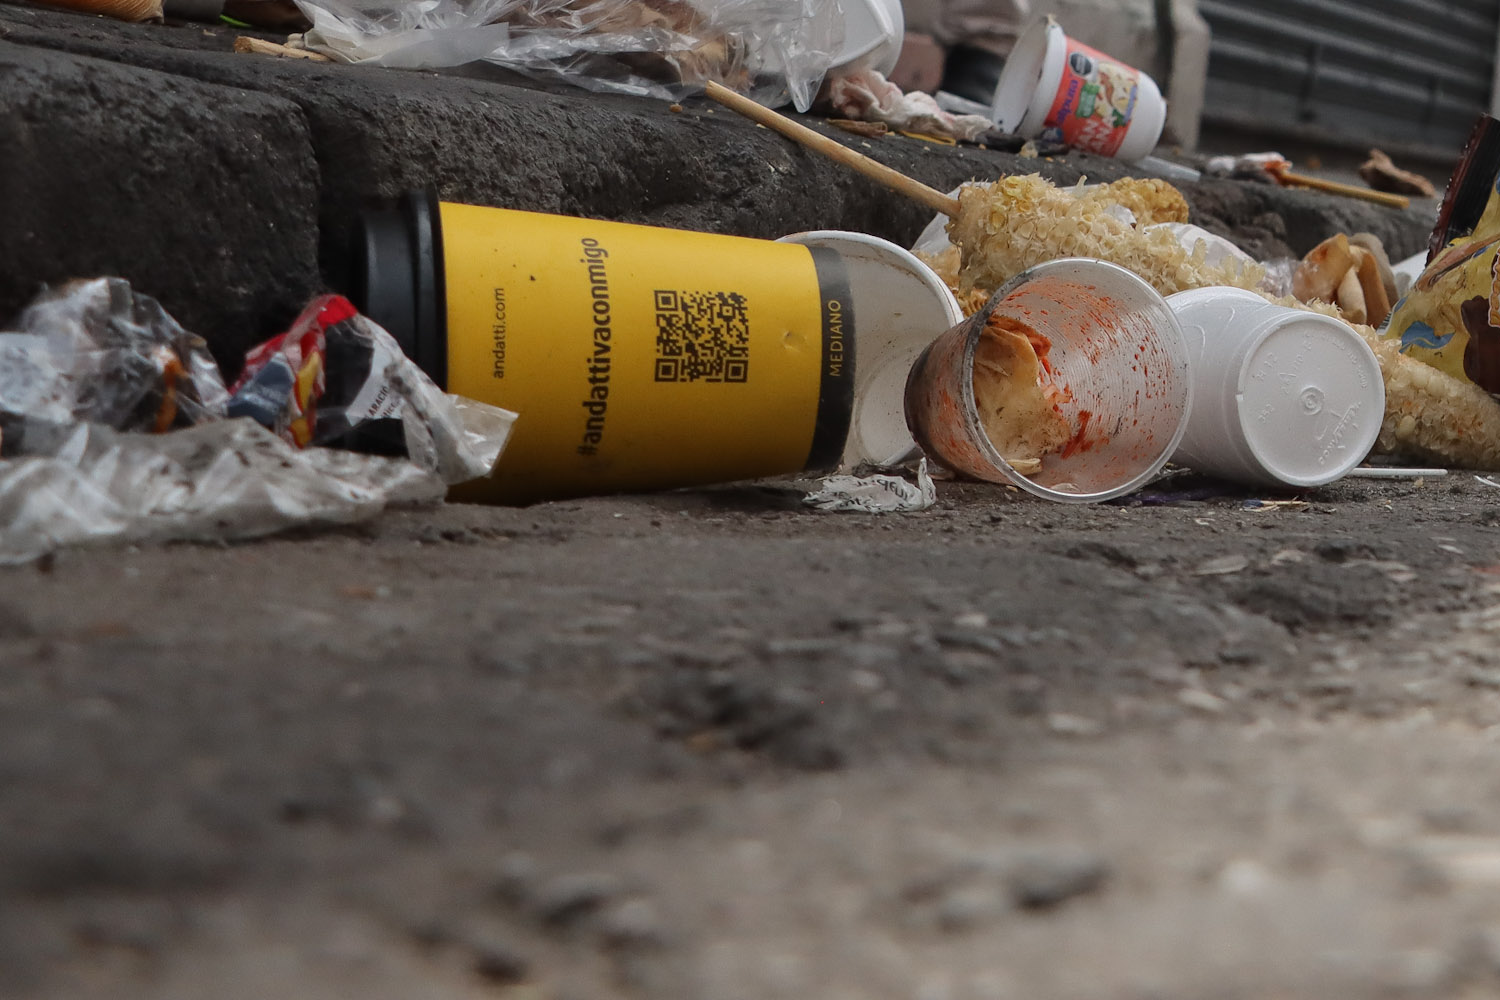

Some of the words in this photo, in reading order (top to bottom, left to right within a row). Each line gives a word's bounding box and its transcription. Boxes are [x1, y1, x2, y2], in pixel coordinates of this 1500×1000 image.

[492, 287, 505, 379] andatti.com
[578, 237, 612, 457] #andattivaconmigo
[828, 300, 842, 377] MEDIANO
